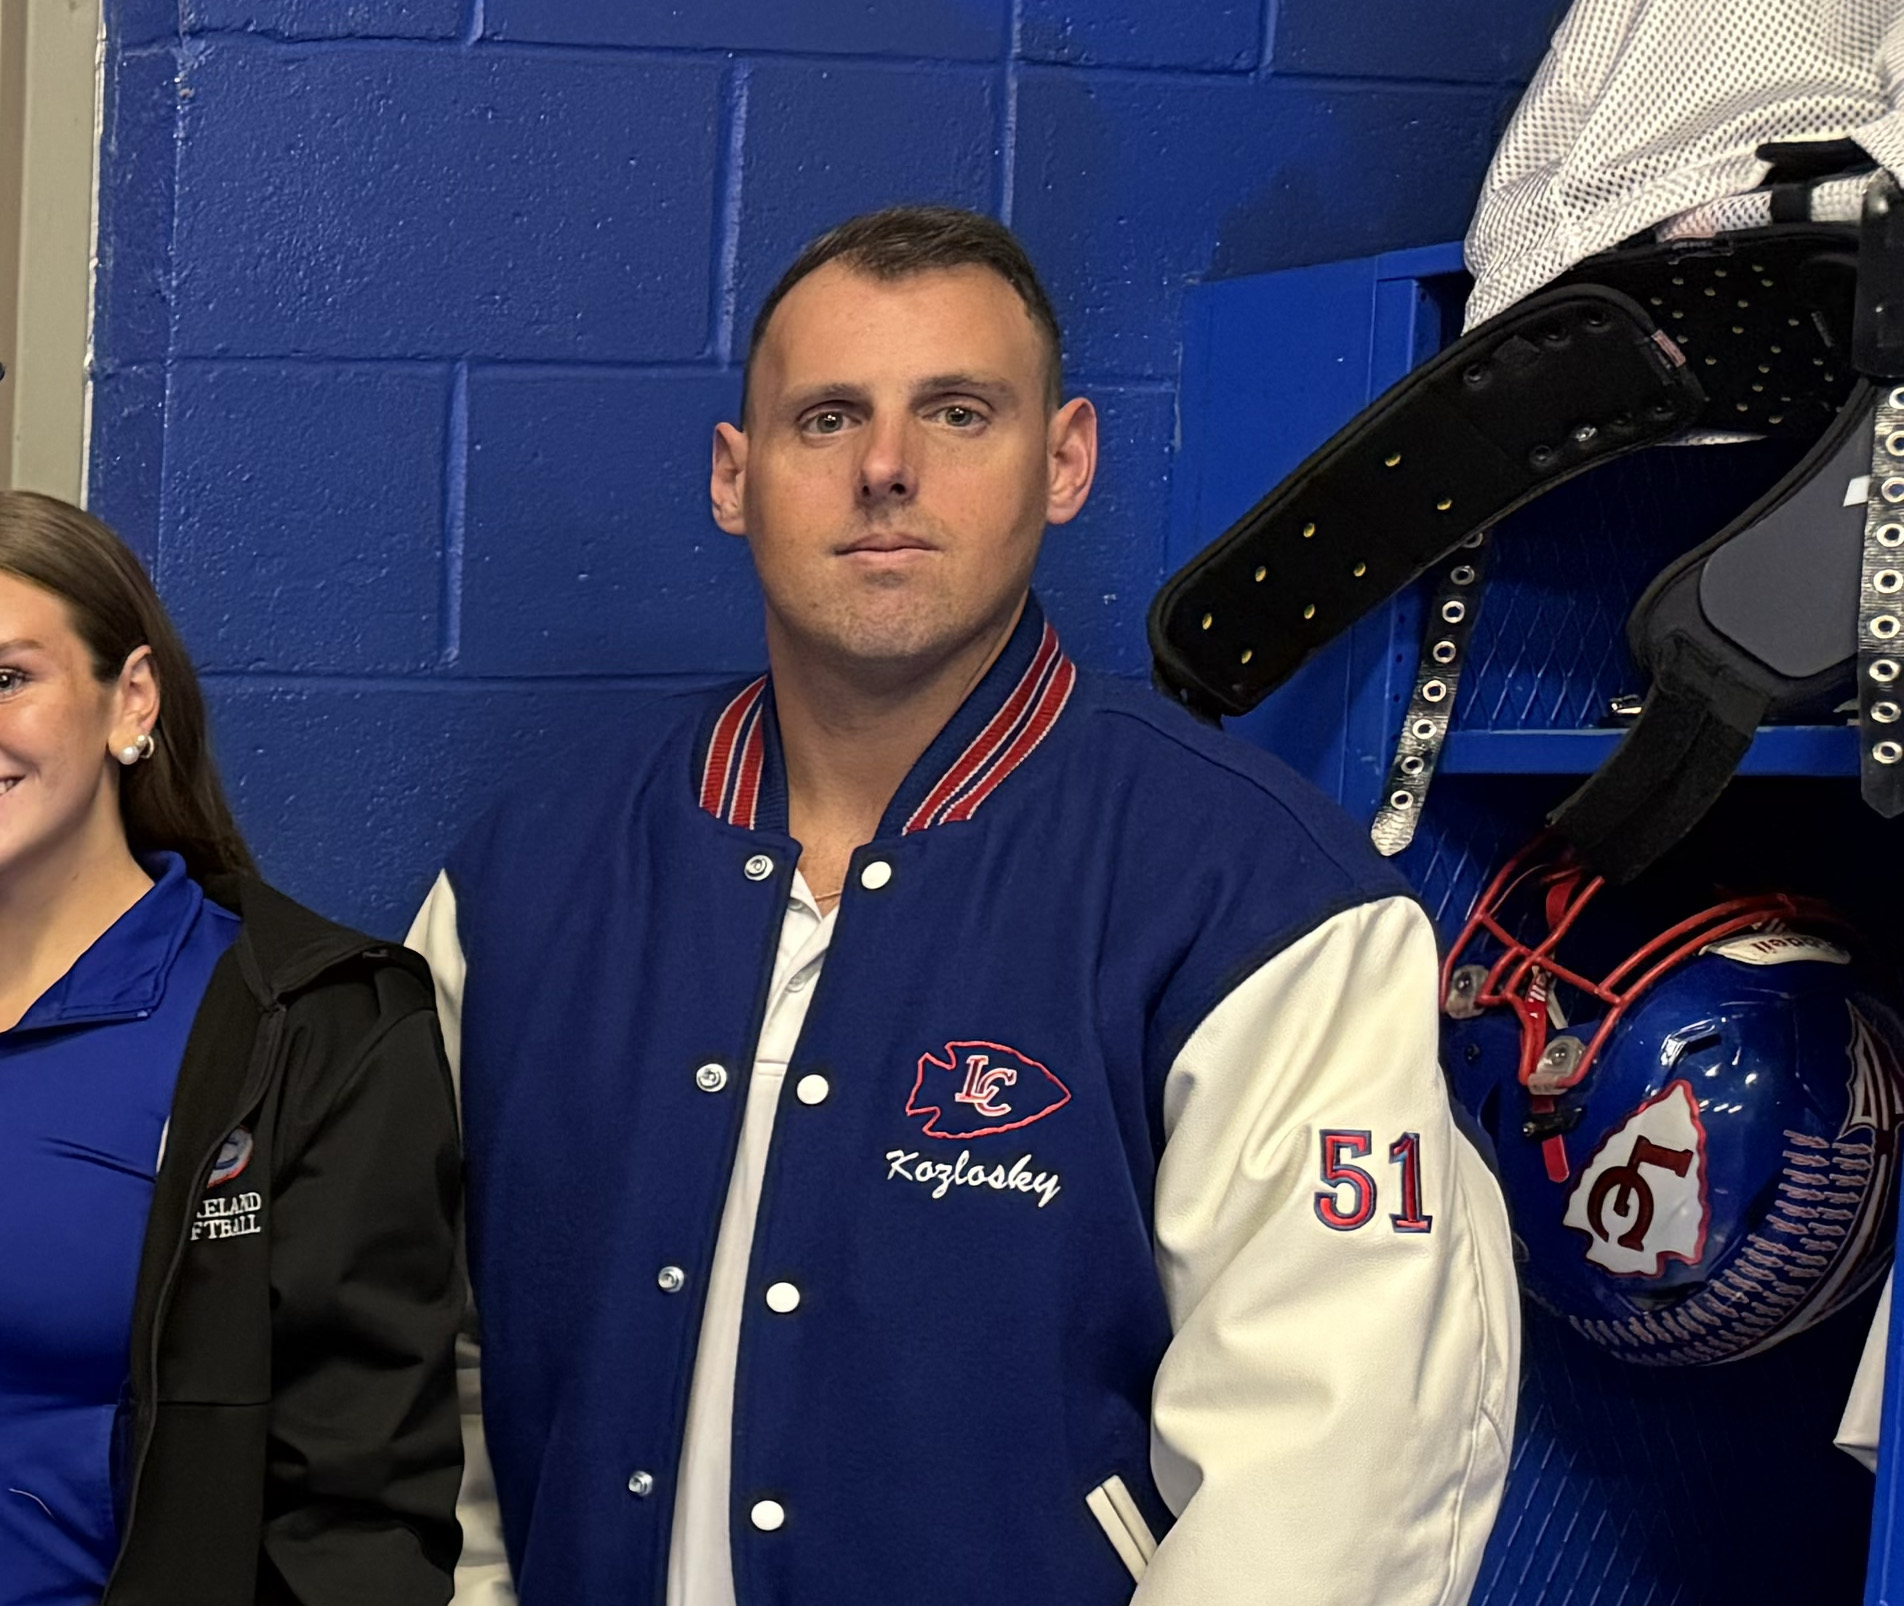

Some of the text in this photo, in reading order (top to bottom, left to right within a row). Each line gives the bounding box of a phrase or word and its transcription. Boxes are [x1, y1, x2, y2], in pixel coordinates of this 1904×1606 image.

[954, 1054, 1017, 1117] LC
[196, 1191, 262, 1219] ELAND
[885, 1149, 1062, 1208] Kozlosky
[1314, 1128, 1433, 1234] 51
[190, 1213, 262, 1241] FTBALL
